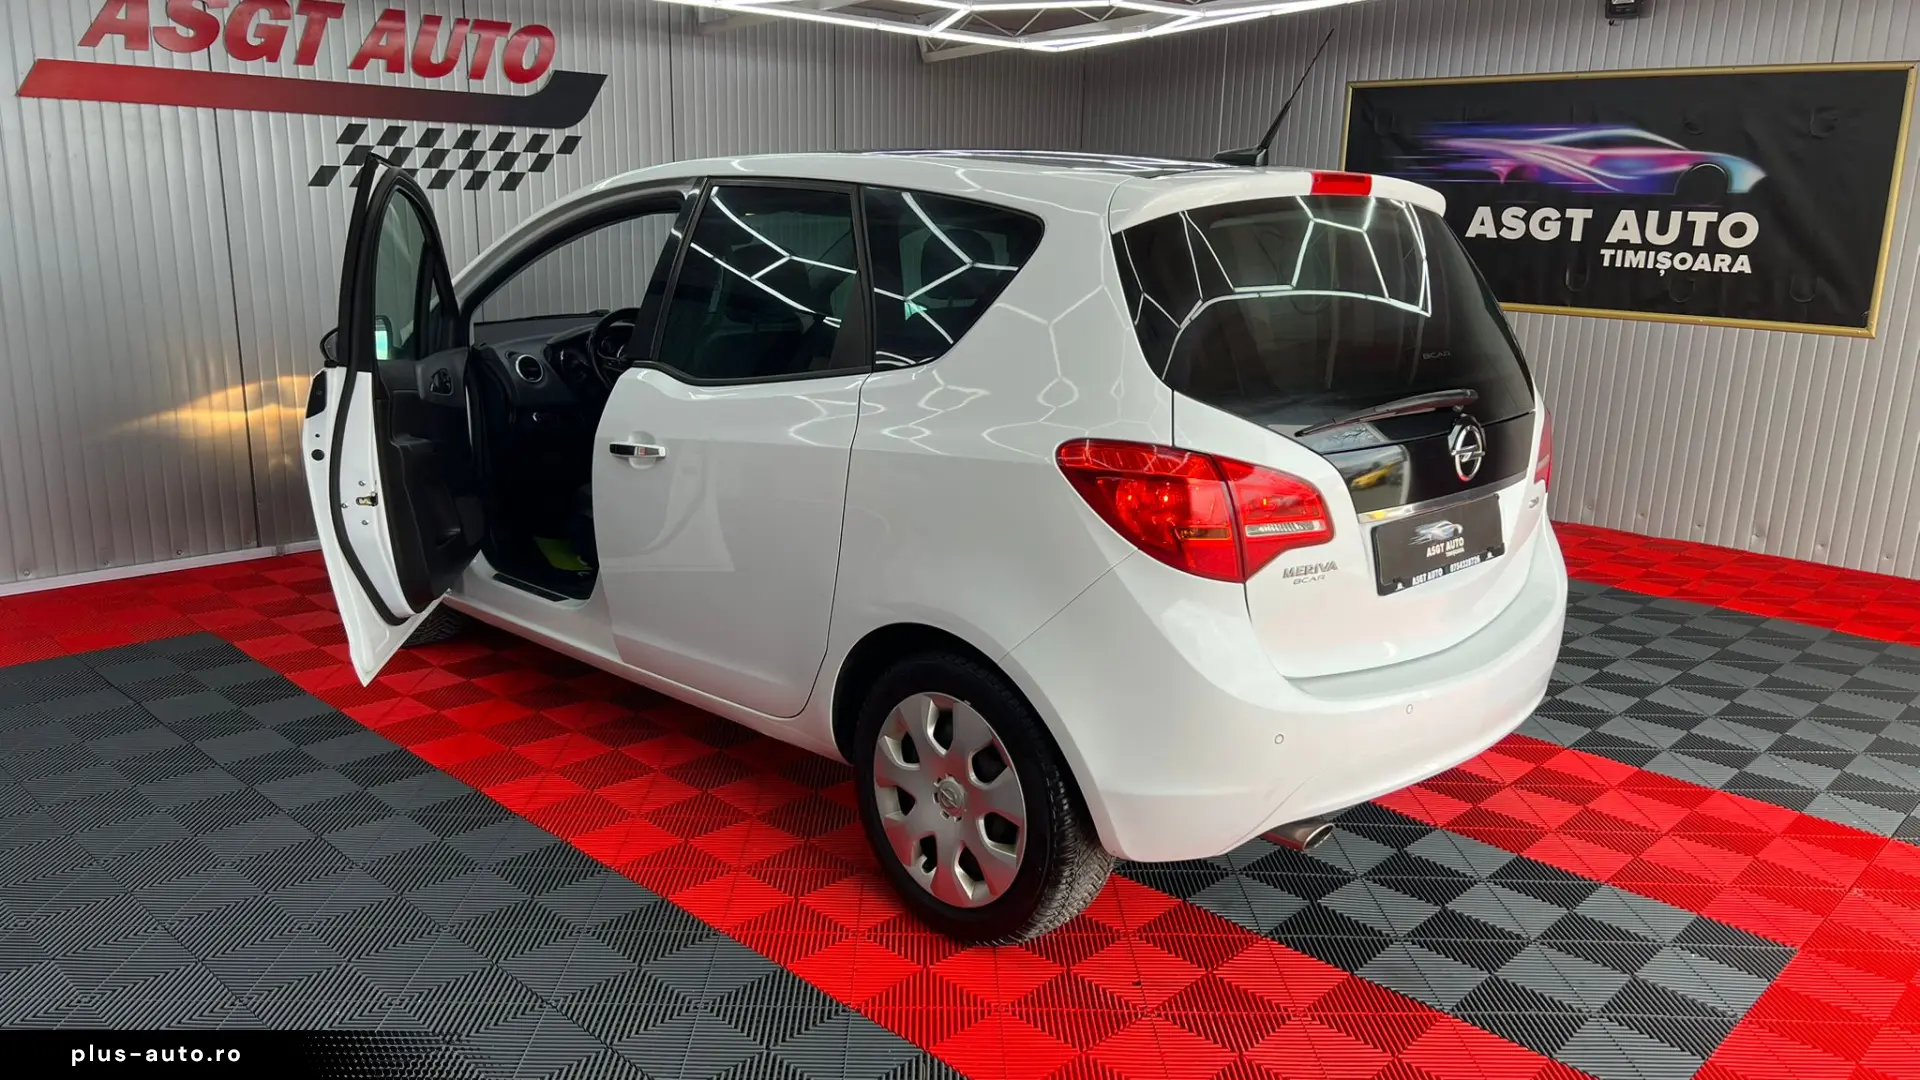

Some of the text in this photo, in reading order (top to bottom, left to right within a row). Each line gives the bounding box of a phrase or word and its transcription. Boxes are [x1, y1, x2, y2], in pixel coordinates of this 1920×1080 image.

[78, 0, 556, 83] ASGT AUTO
[1465, 206, 1760, 249] ASGT AUTO
[1599, 249, 1752, 277] TIMIȘOARA
[1426, 542, 1445, 558] ASGT
[1445, 537, 1465, 551] AUTO
[1282, 560, 1338, 579] MERIVA
[1427, 567, 1443, 581] AUTO
